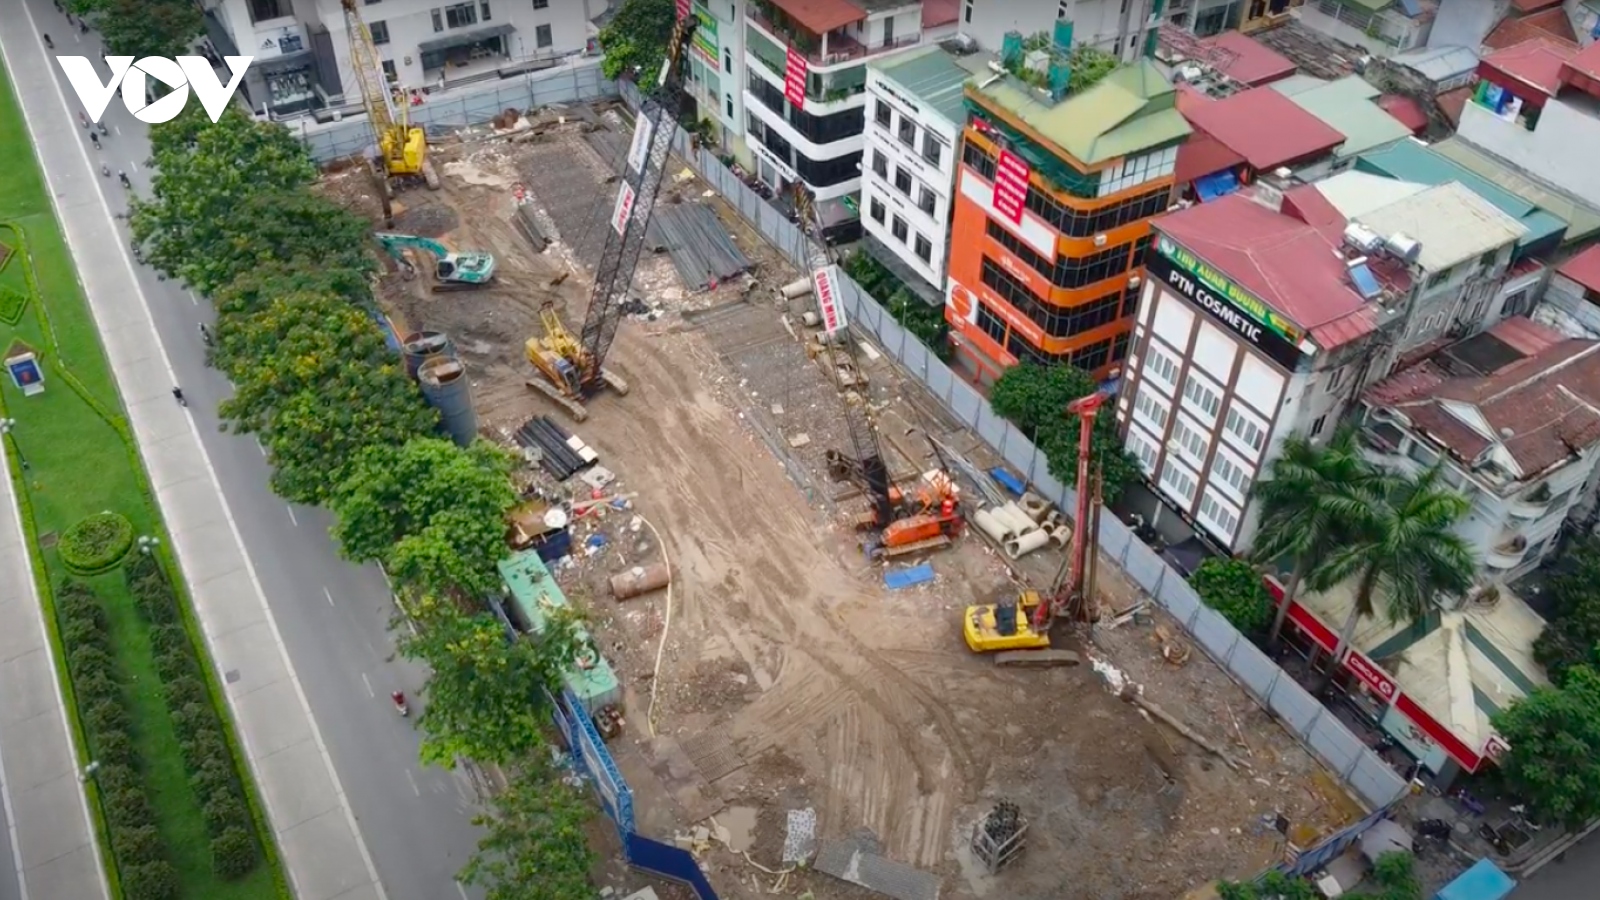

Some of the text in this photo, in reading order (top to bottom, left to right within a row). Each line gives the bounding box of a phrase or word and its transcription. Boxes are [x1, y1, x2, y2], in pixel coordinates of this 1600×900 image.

[816, 271, 833, 305] QUANG
[1169, 270, 1262, 343] PTN COSMETIC
[1351, 657, 1379, 683] CIRCLE
